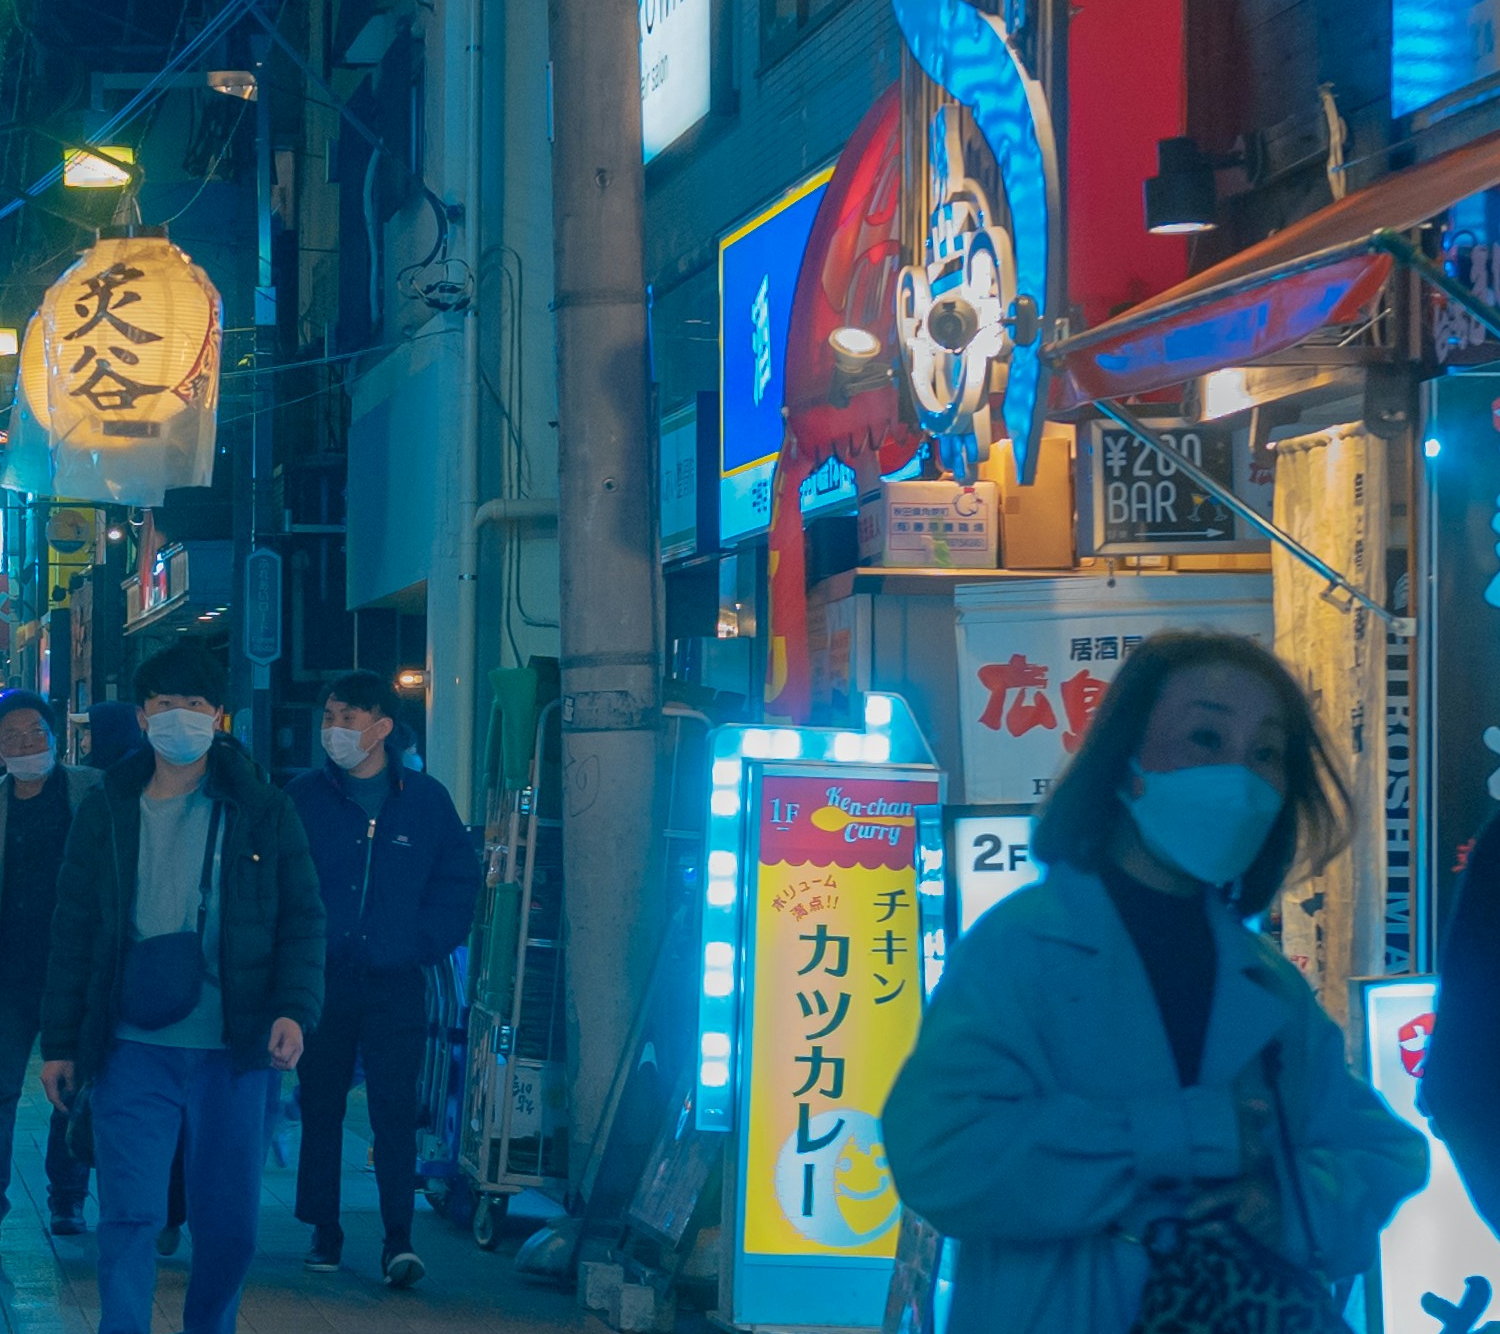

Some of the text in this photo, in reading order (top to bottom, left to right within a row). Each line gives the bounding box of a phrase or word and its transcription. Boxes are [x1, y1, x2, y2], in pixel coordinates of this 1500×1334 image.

[1104, 433, 1201, 477] ¥200
[1107, 481, 1178, 524] BAR
[769, 798, 800, 824] 1F
[825, 786, 912, 817] Ken-chan
[1386, 631, 1411, 977] HIROSHIMA
[844, 822, 902, 847] Curry
[972, 832, 1029, 873] 2F
[771, 873, 838, 913] ボリューム
[869, 888, 913, 1007] チキン
[791, 923, 853, 1218] カツカレー
